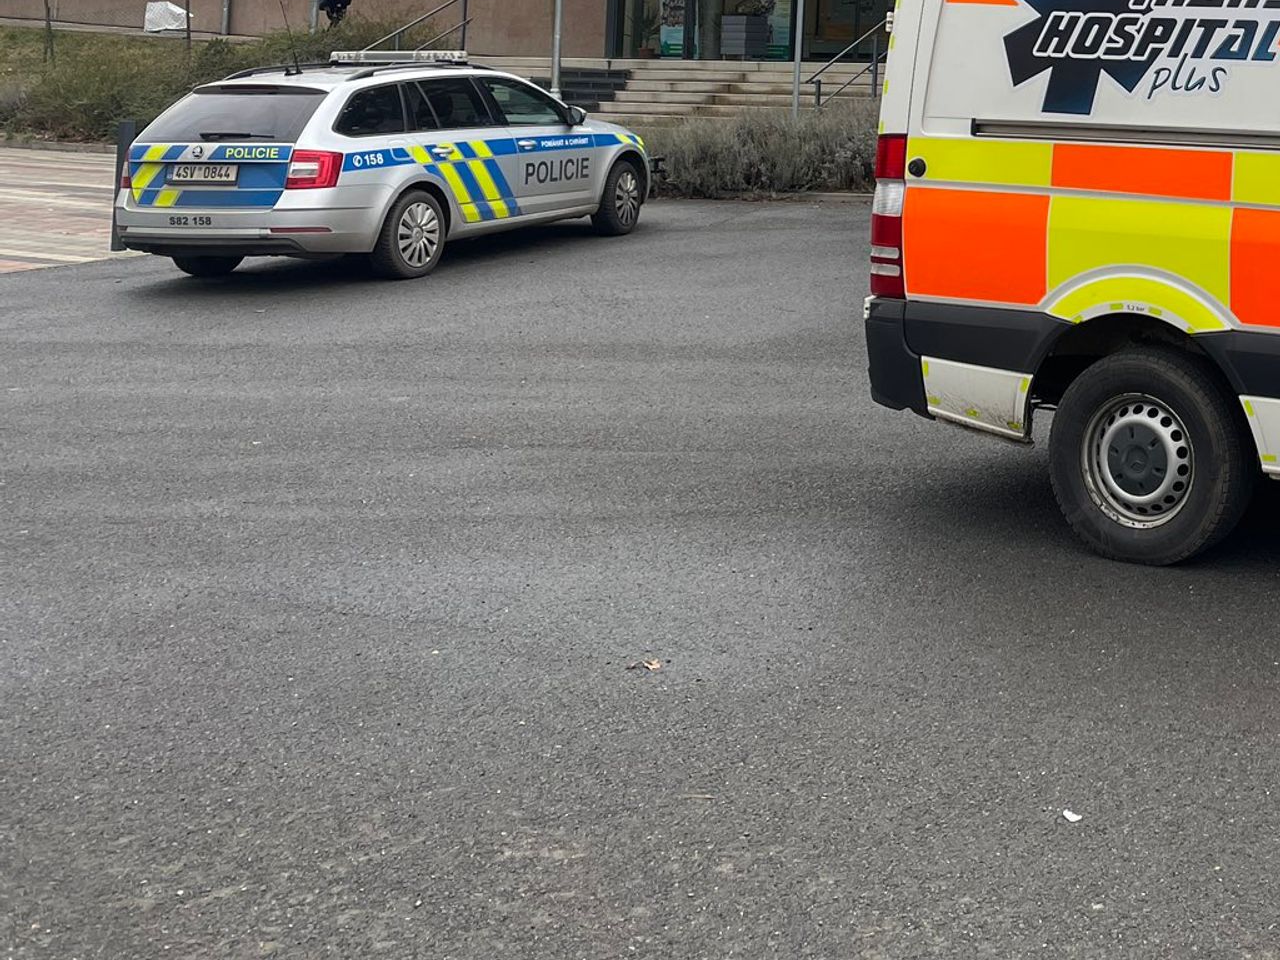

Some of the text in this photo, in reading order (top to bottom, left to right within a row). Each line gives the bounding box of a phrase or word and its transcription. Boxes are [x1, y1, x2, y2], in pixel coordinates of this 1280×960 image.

[1147, 52, 1228, 100] plus
[225, 147, 279, 159] POLICIE
[363, 153, 384, 166] 158
[175, 164, 231, 179] 4SV 0844
[525, 157, 590, 185] POLICIE
[169, 216, 212, 226] S82 158
